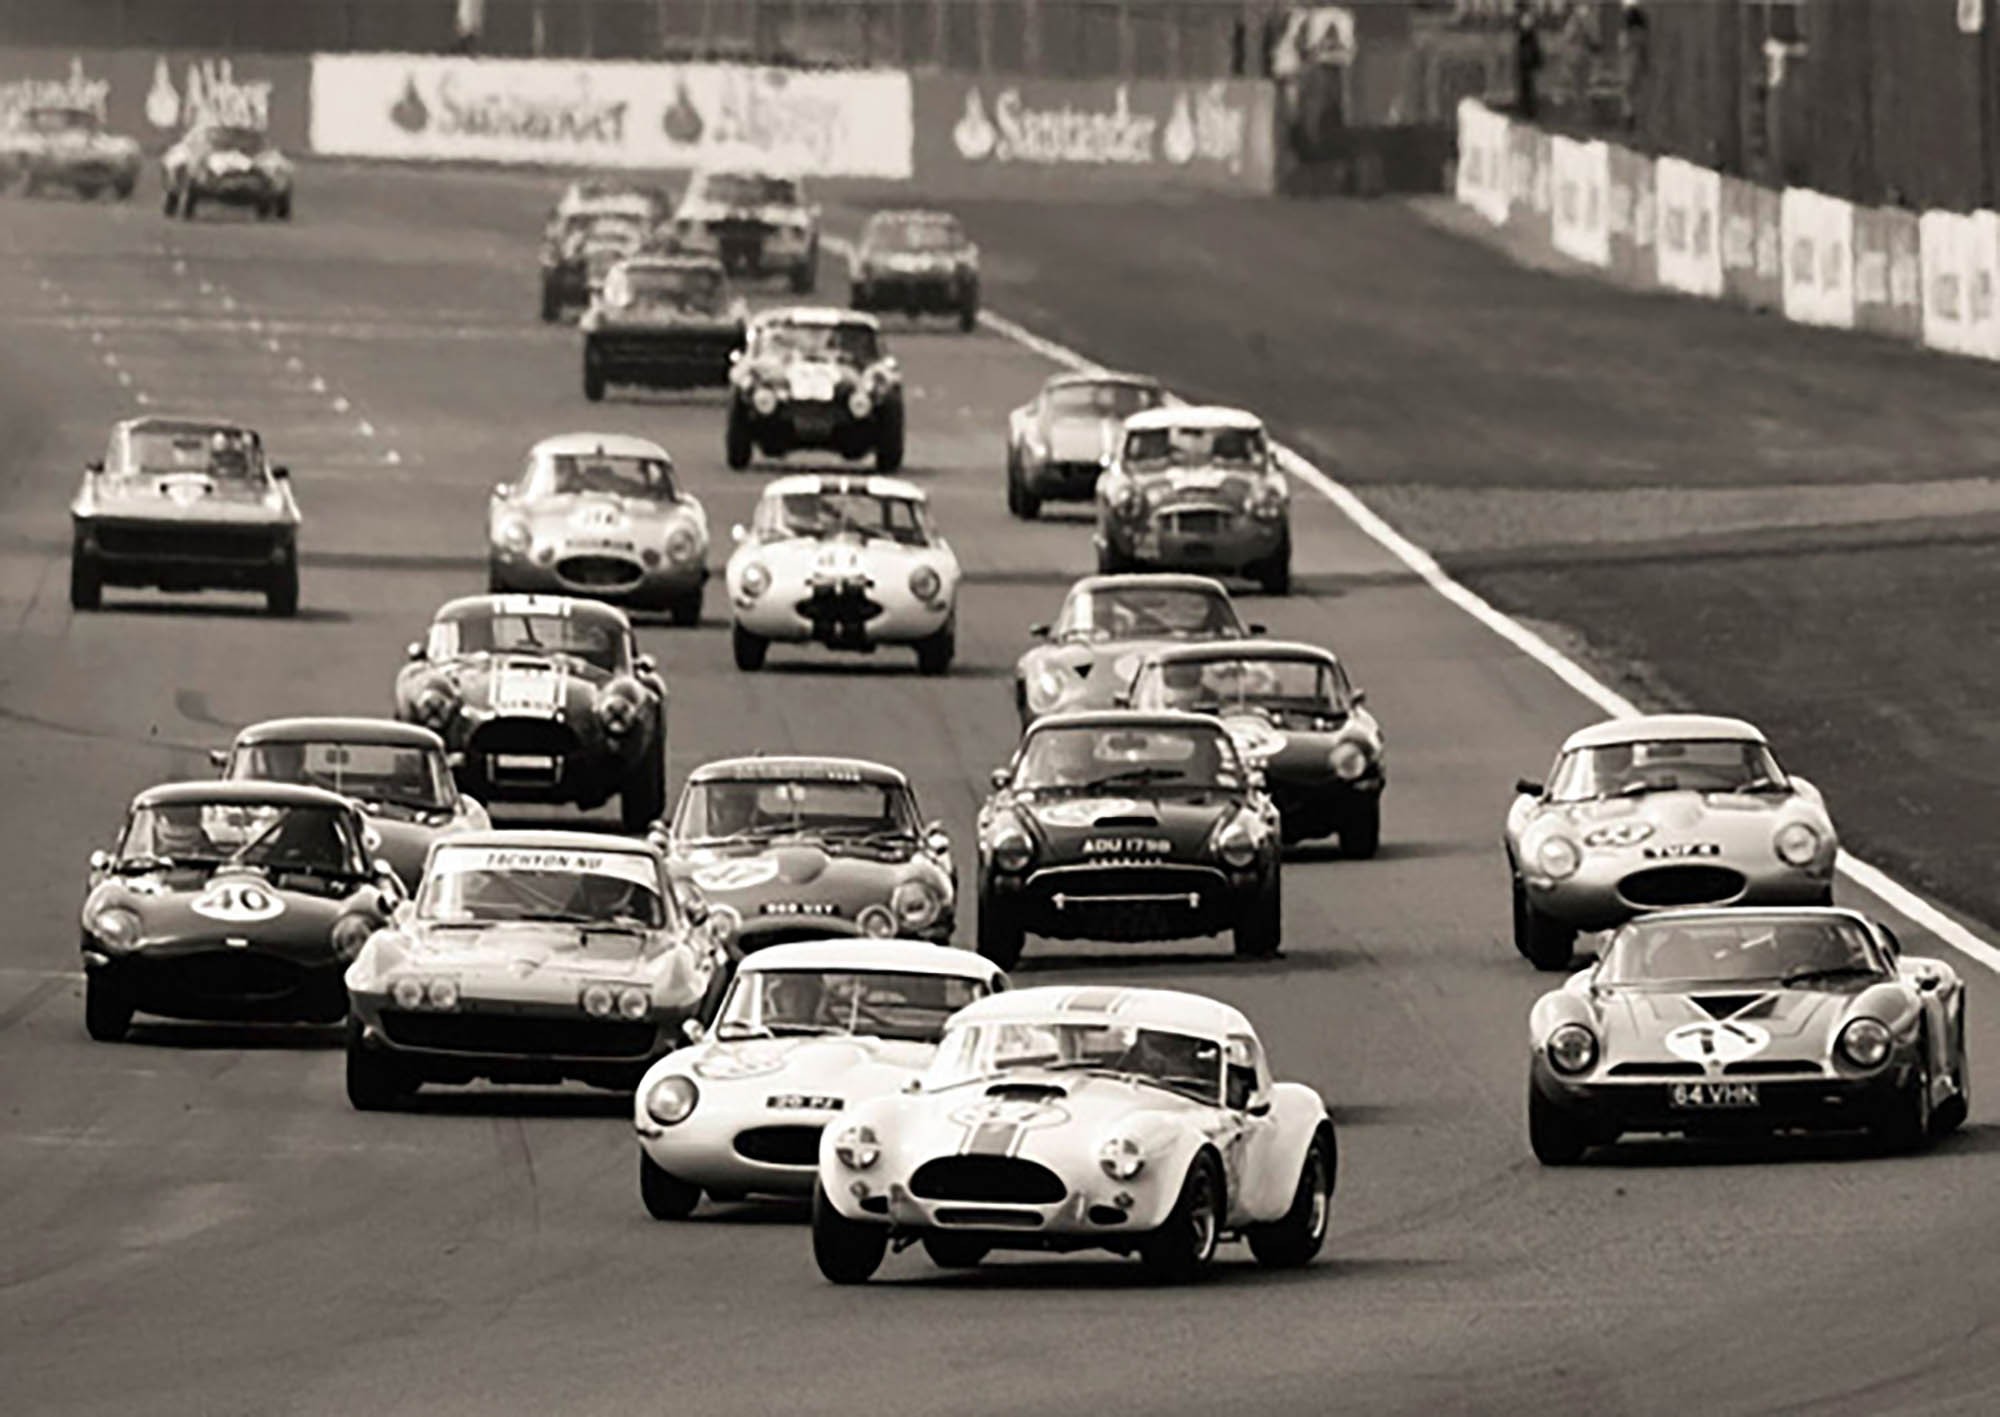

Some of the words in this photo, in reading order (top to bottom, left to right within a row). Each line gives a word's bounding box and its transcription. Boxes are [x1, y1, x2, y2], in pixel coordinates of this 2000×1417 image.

[1083, 838, 1122, 853] ADU
[201, 888, 270, 911] 40
[1674, 1082, 1703, 1105] 64
[1708, 1082, 1759, 1105] VHN
